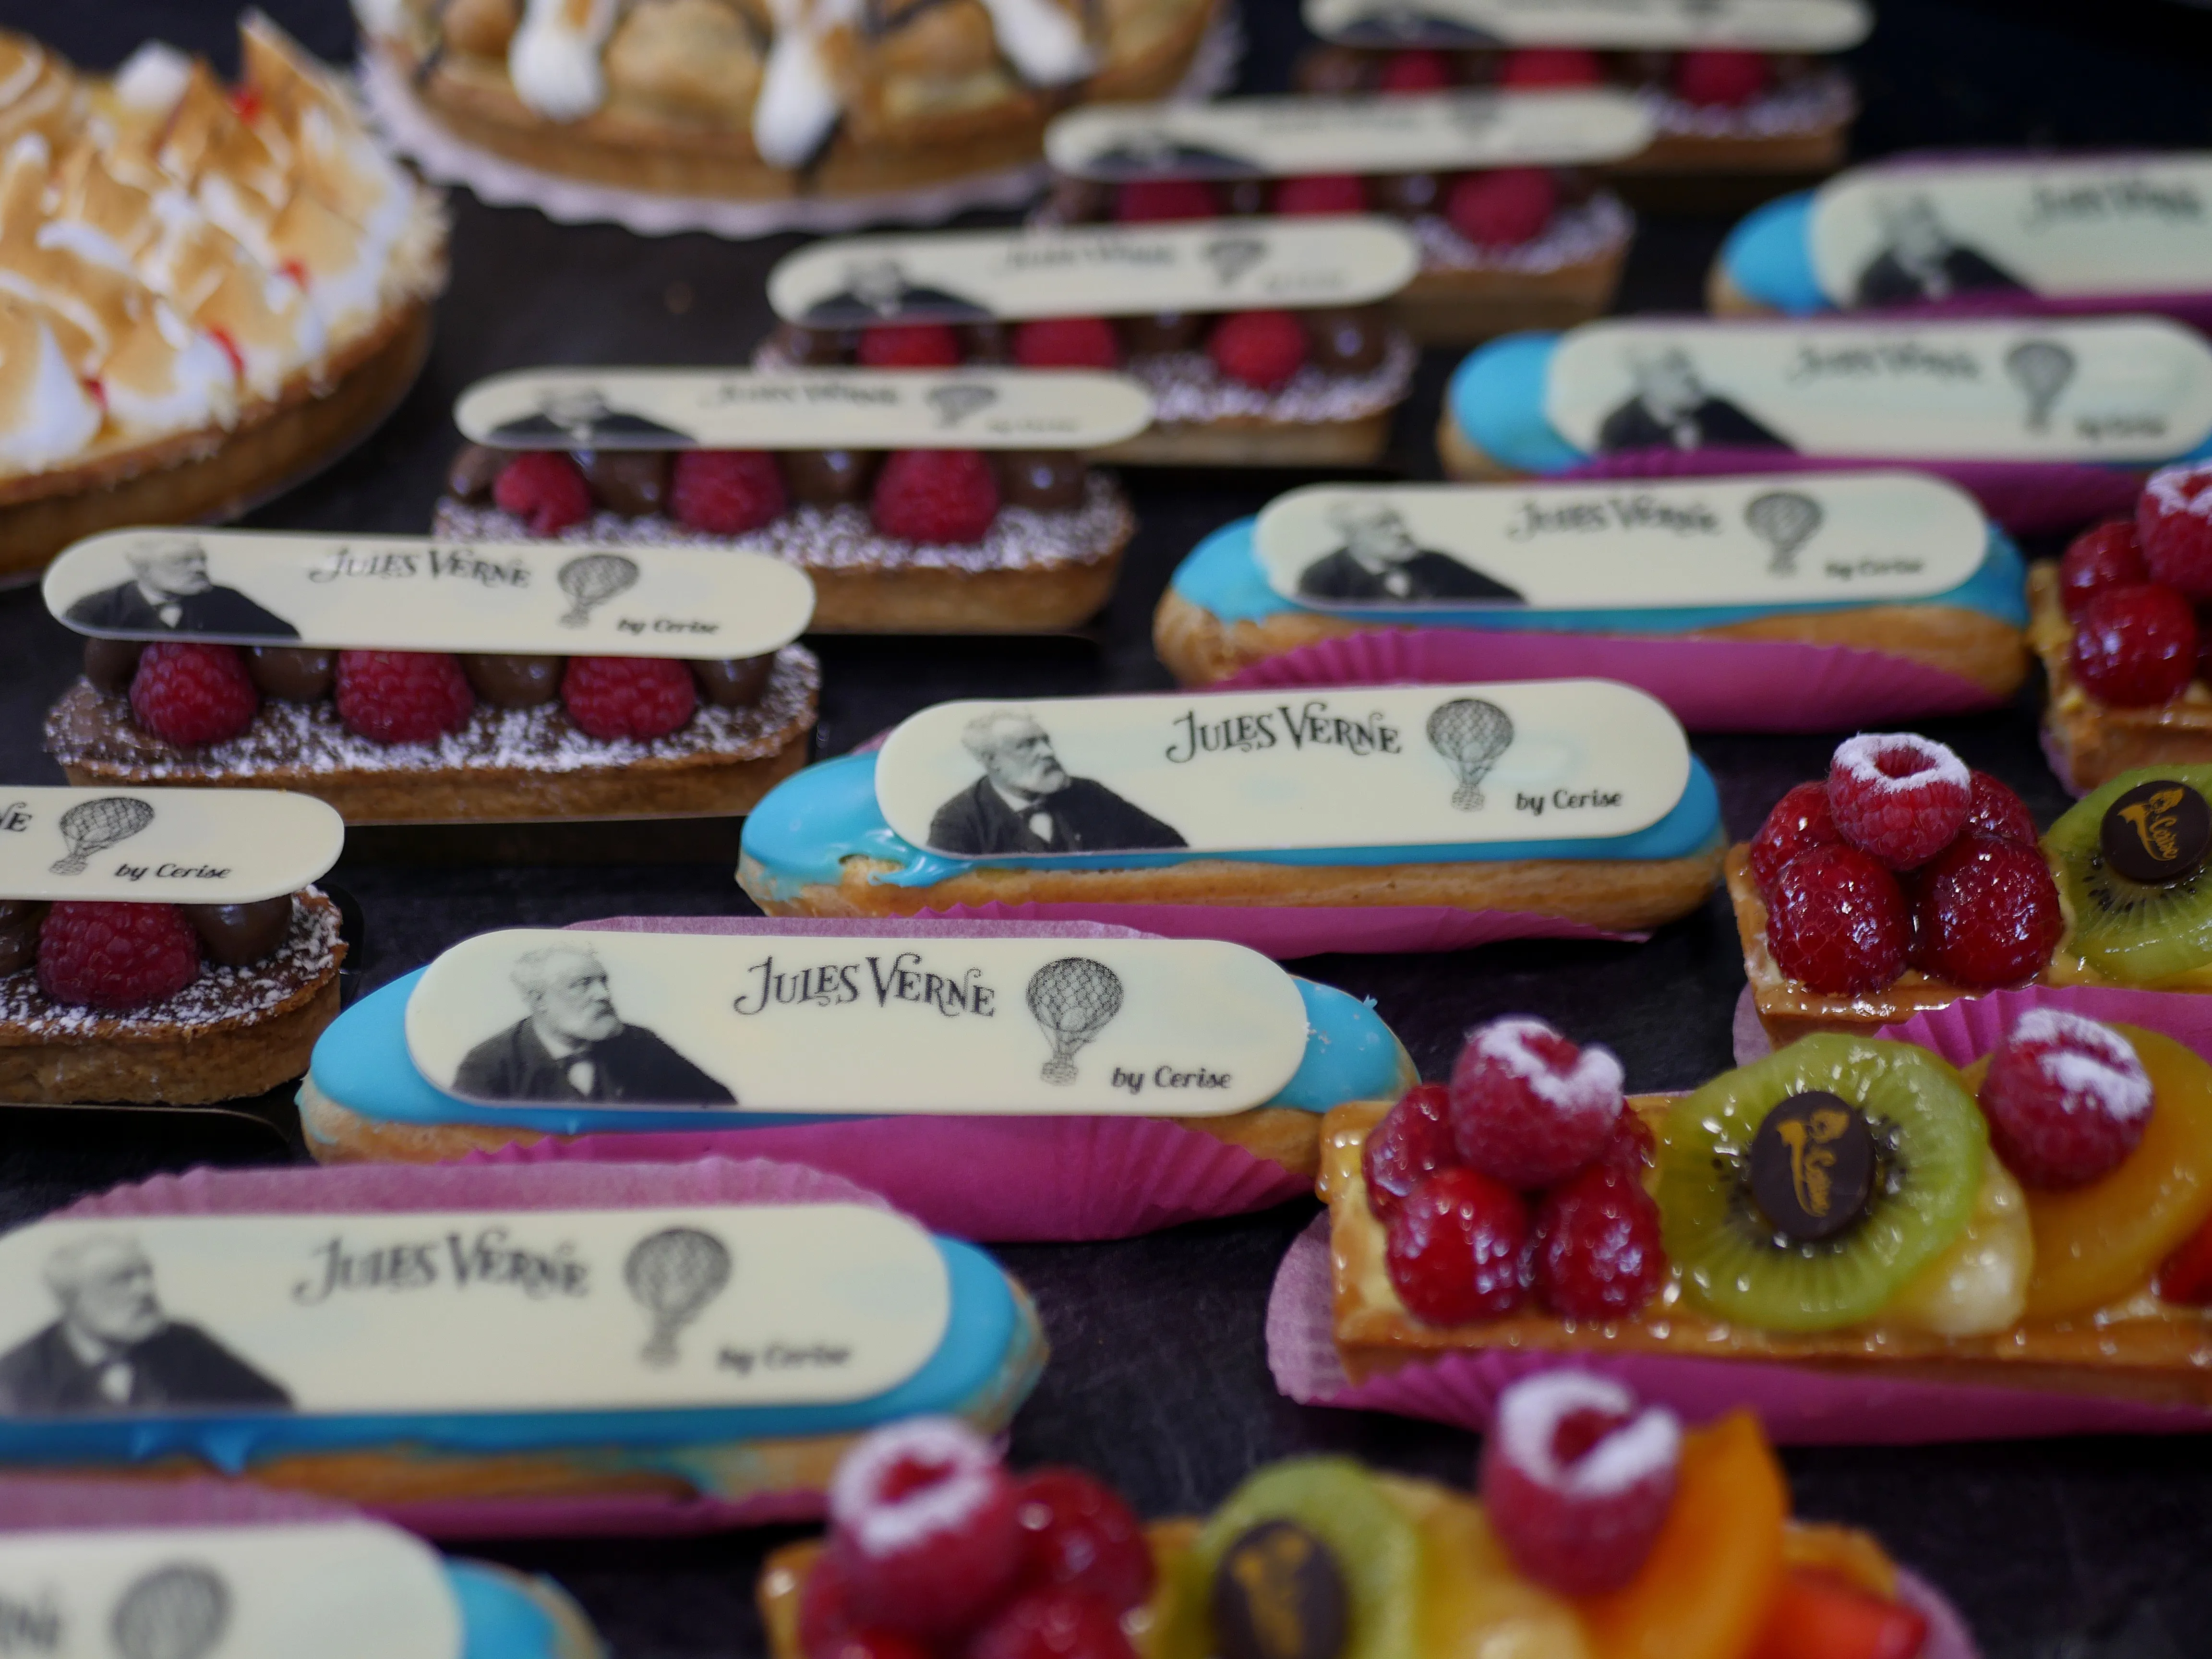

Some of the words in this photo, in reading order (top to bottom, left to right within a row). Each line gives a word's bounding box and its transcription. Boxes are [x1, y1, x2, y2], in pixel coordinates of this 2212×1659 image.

[306, 546, 418, 584] JULES
[425, 547, 532, 589] VERNE
[1165, 709, 1277, 764] JULES
[1277, 701, 1403, 757] VERNE
[1515, 791, 1546, 817] by
[1551, 788, 1623, 810] Cerise
[114, 863, 148, 882] by
[153, 863, 232, 879] Cerise
[733, 954, 860, 1015] JULES
[865, 951, 996, 1019] VERNE
[1110, 1066, 1145, 1095] by
[1152, 1064, 1232, 1090] Cerise
[292, 1234, 441, 1307] JULES
[444, 1225, 590, 1301] VERNE
